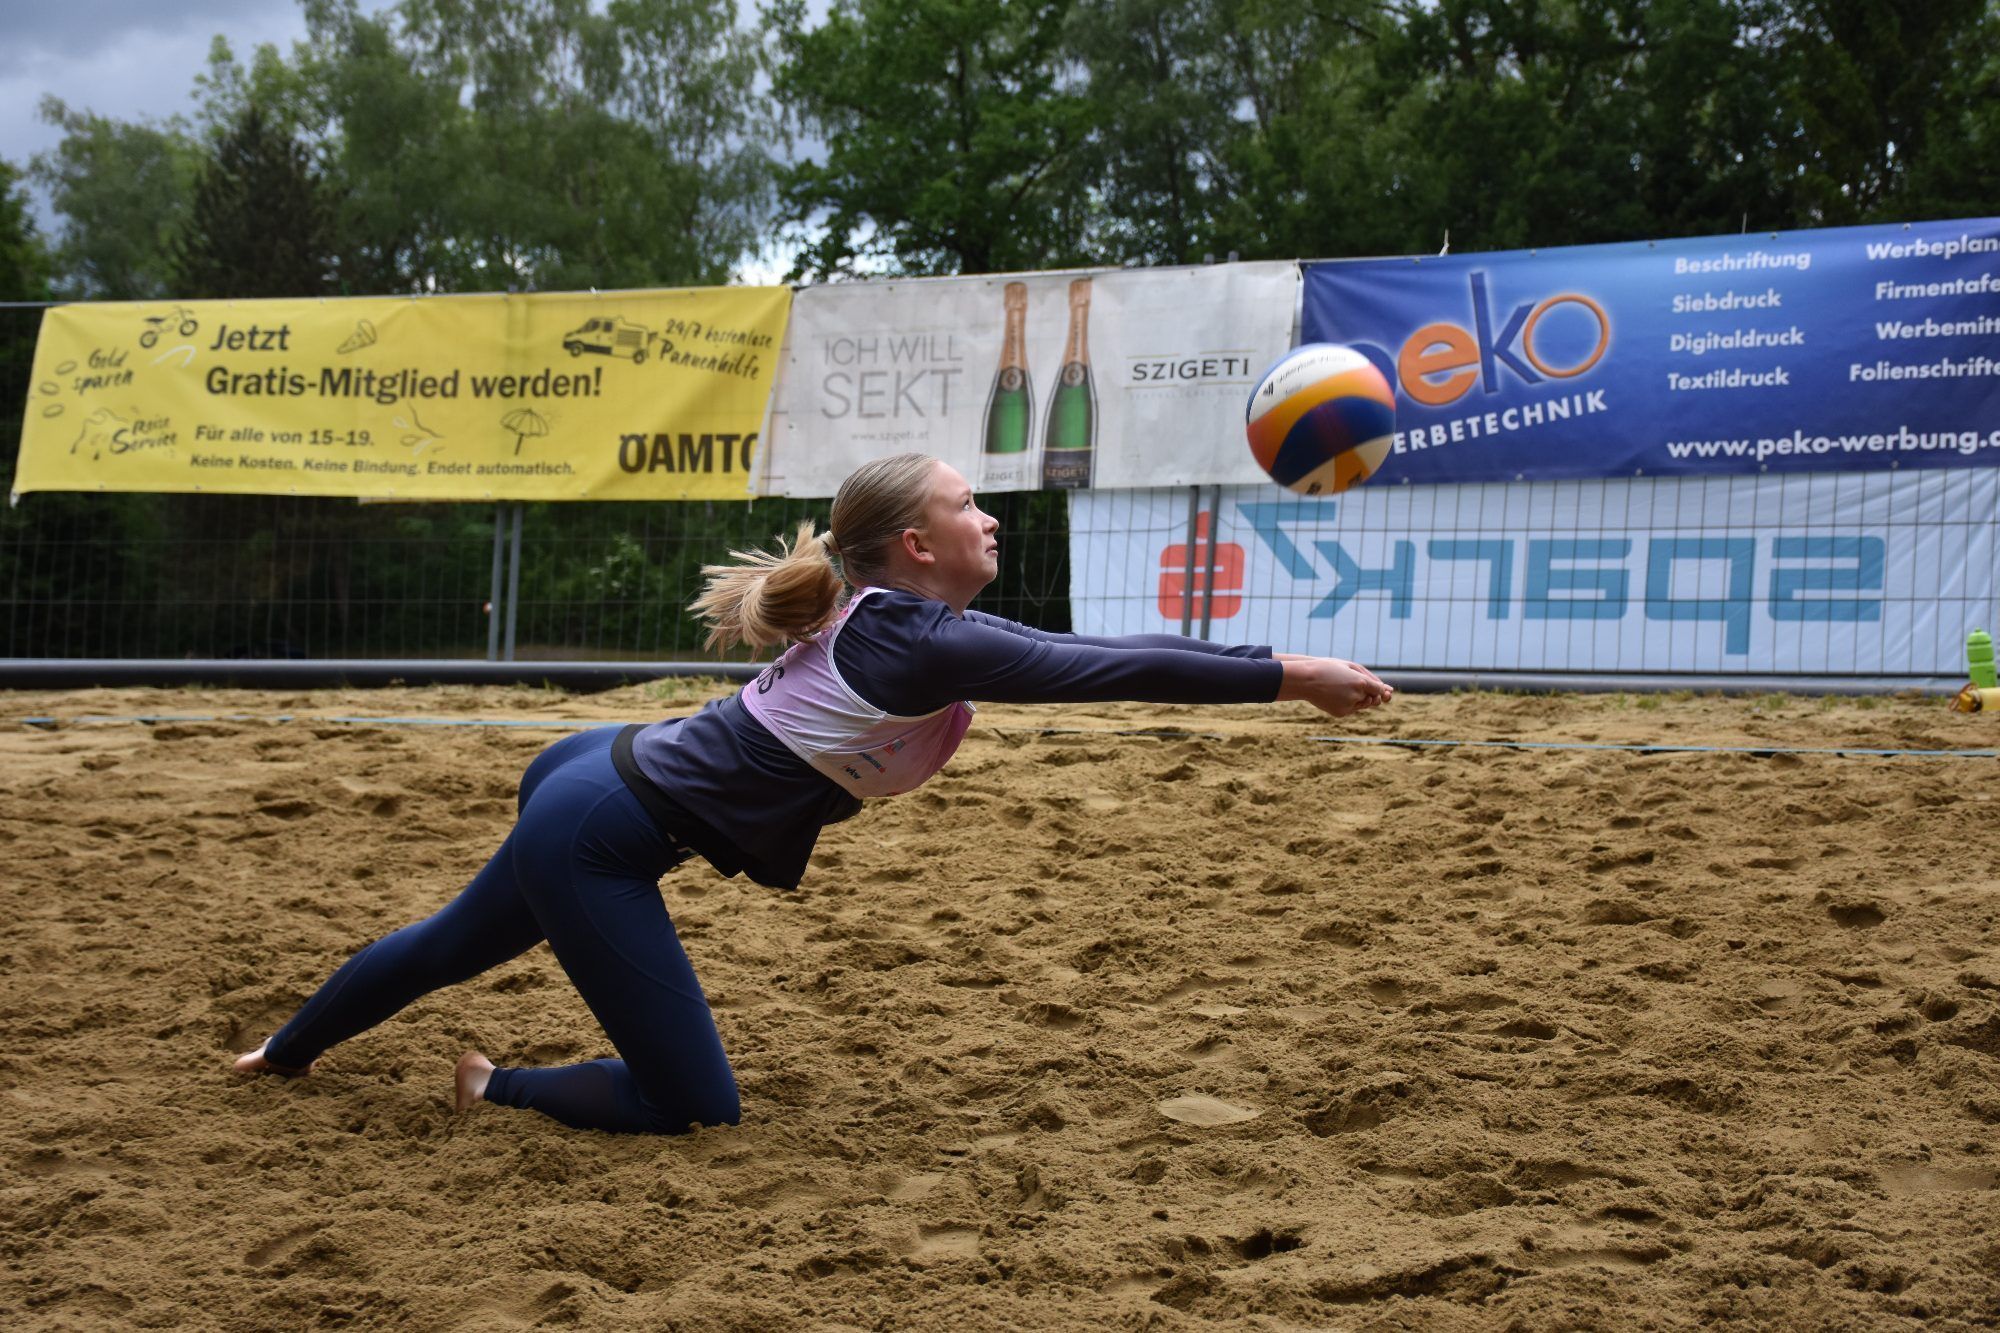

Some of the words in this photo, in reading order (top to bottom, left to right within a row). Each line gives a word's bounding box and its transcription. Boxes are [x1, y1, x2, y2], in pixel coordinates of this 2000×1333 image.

[1866, 234, 2000, 260] Werbeplan
[1674, 251, 1811, 274] Beschriftung
[1671, 288, 1782, 313] Siebdruck
[209, 324, 291, 351] Jetzt
[665, 318, 702, 340] 24/7
[704, 326, 773, 349] kostenlose
[1670, 326, 1805, 355] Digitaldruck
[658, 338, 760, 380] Pannenhilfe
[824, 337, 879, 366] ICH
[888, 335, 963, 363] WILL
[1132, 358, 1249, 381] SZIGETI
[1667, 366, 1790, 390] Textildruck
[205, 366, 460, 405] Gratis-Mitglied
[471, 367, 602, 398] werden!
[820, 367, 963, 420] SEKT
[195, 425, 224, 441] Für
[230, 427, 264, 443] alle
[271, 431, 302, 444] von
[1393, 389, 1609, 455] ERBETECHNIK
[190, 455, 233, 469] Keine
[239, 455, 298, 470] Kosten.
[303, 458, 348, 472] Keine
[353, 460, 421, 475] Bindung.
[427, 461, 471, 475] Endet
[476, 461, 576, 476] automatisch.
